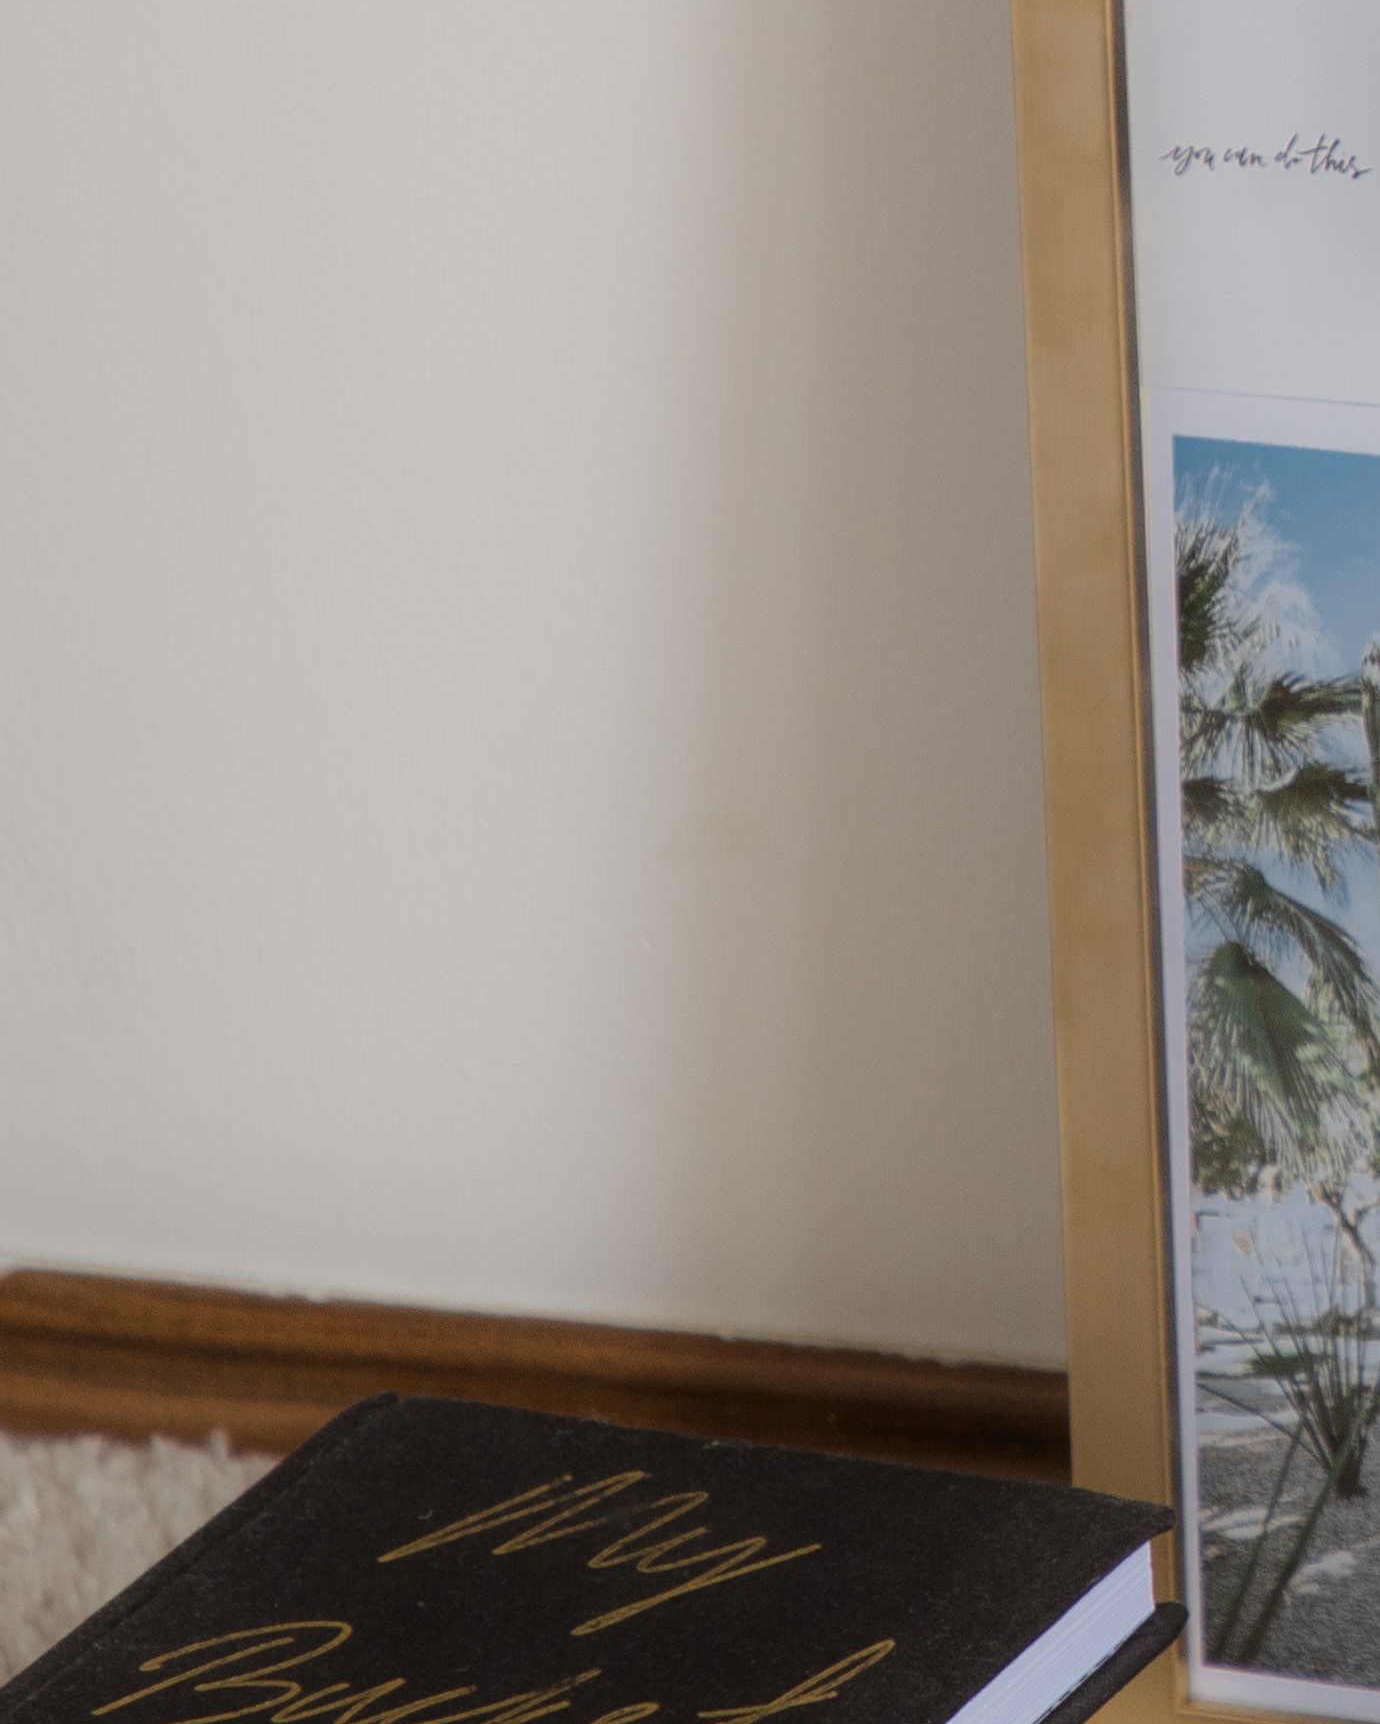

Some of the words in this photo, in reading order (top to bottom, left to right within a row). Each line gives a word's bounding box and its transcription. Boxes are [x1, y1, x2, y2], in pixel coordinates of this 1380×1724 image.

[1159, 145, 1216, 176] you
[1223, 146, 1266, 168] can
[1274, 132, 1302, 170] do
[1301, 133, 1374, 180] this
[377, 1469, 823, 1636] My
